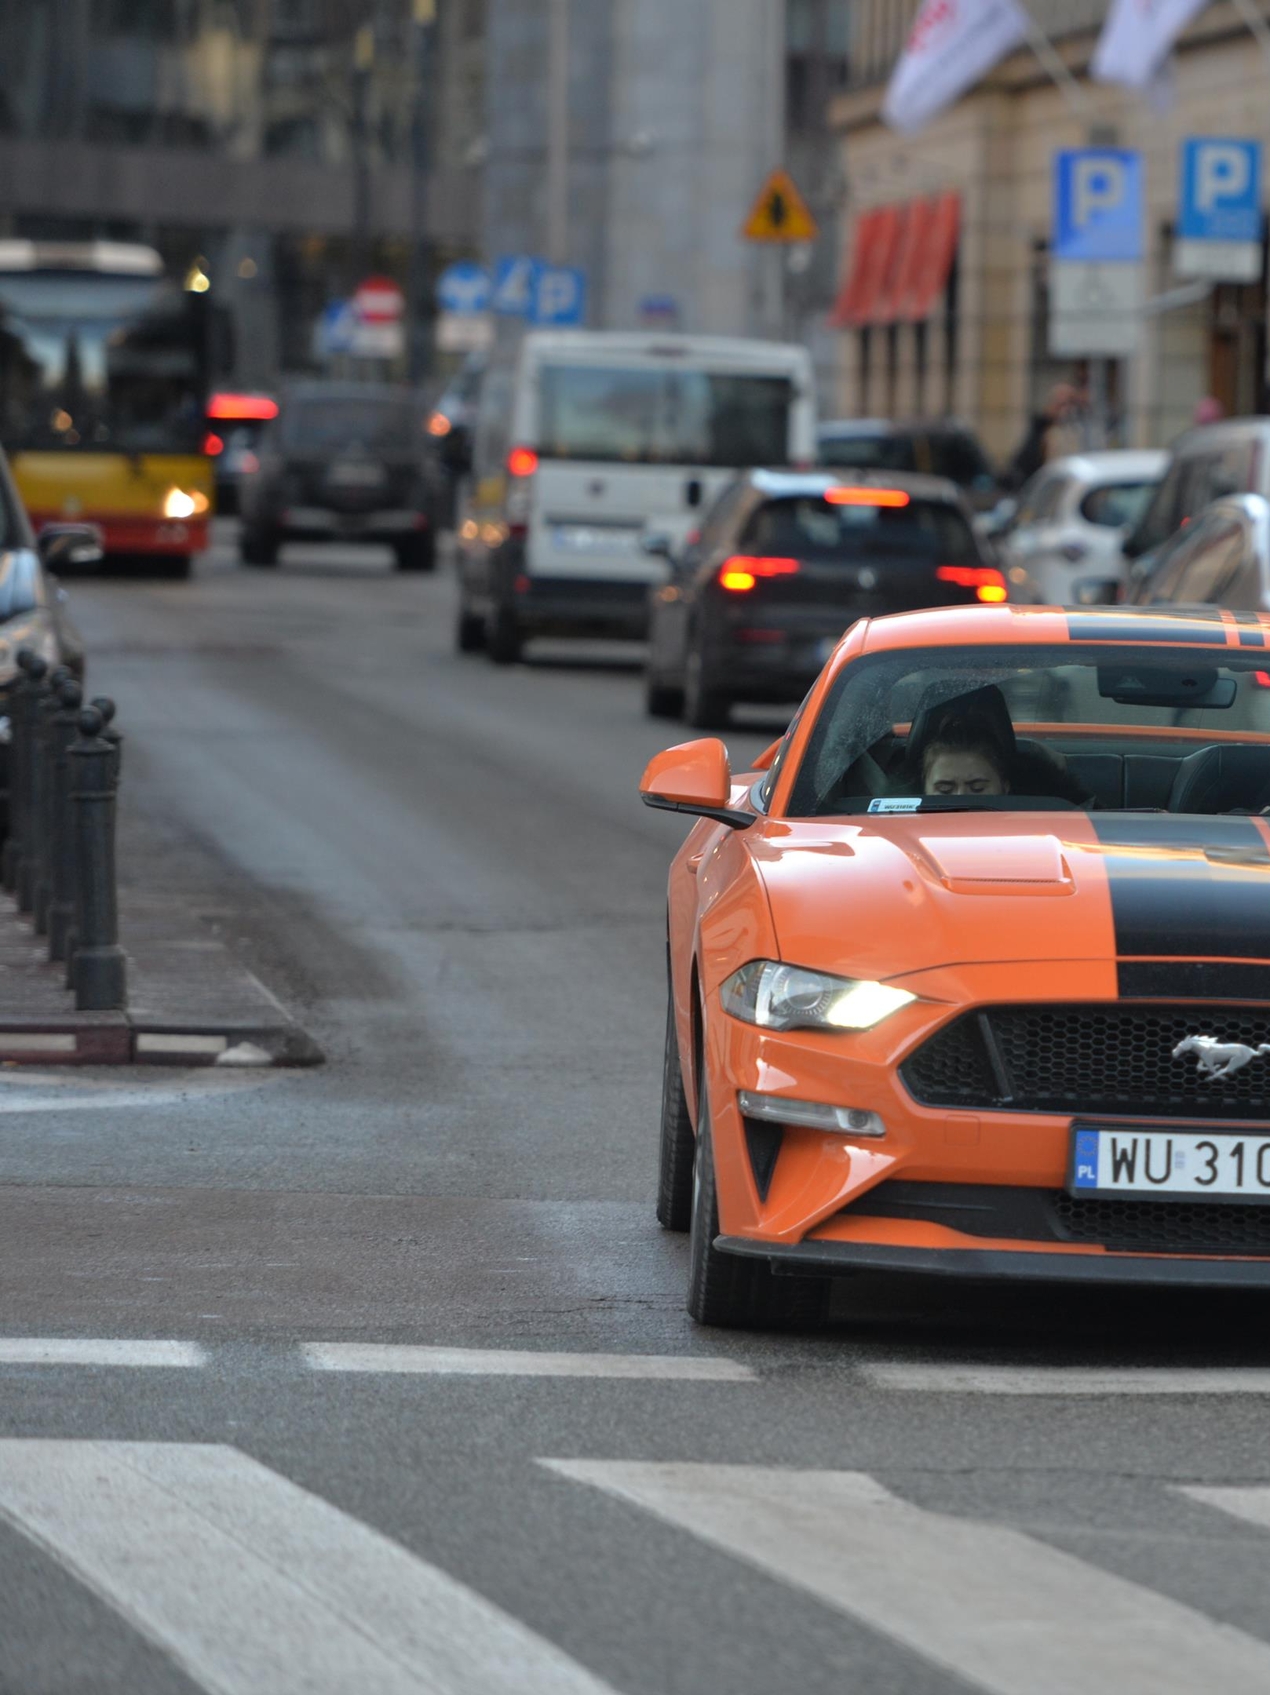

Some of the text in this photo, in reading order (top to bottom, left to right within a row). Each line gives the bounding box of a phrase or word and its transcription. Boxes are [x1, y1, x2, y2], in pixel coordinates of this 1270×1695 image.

[1073, 158, 1126, 227] P
[1195, 147, 1249, 213] P
[1078, 1165, 1095, 1180] PL
[1110, 1137, 1173, 1184] WU
